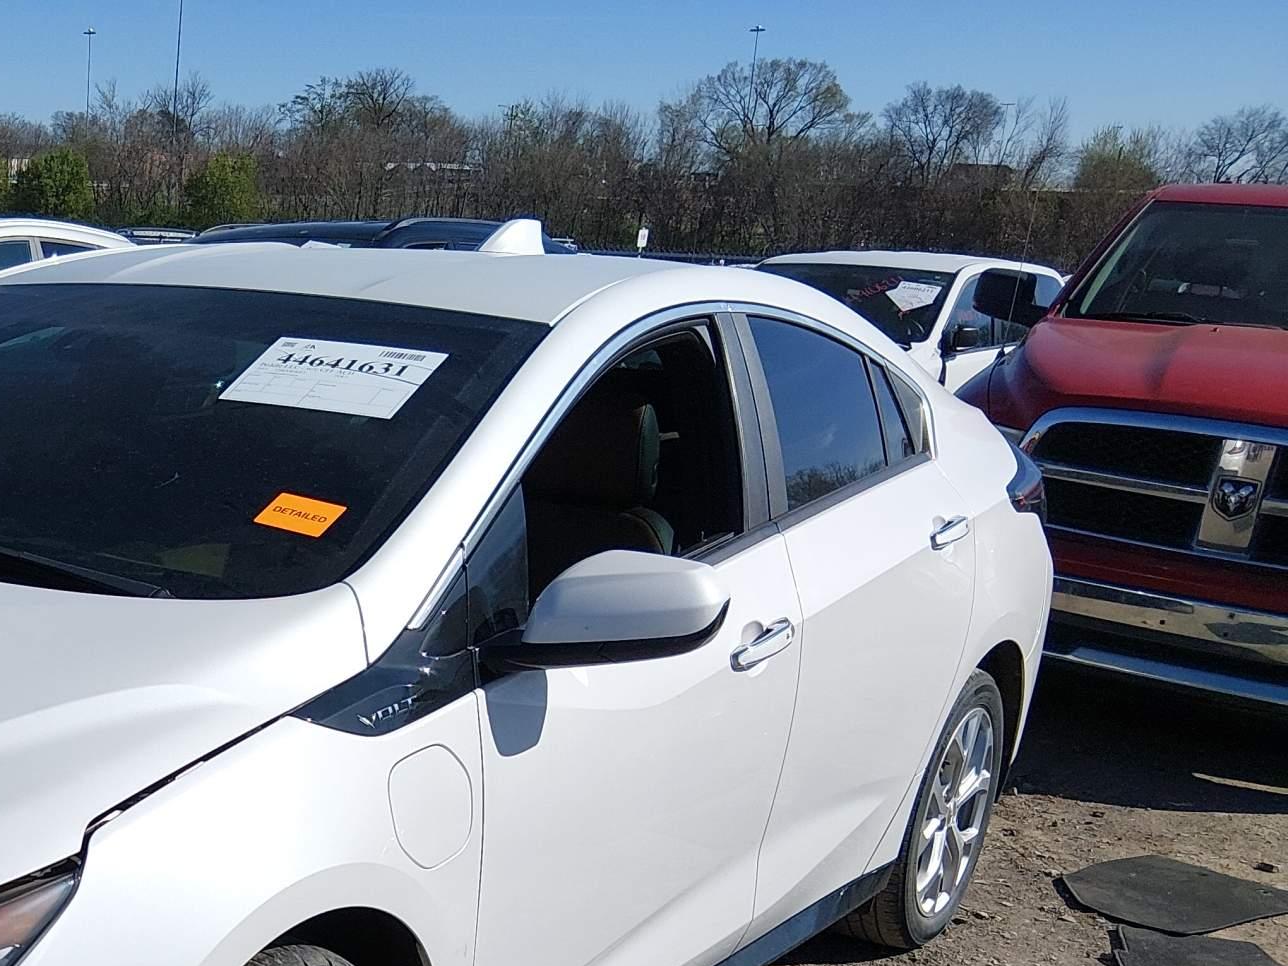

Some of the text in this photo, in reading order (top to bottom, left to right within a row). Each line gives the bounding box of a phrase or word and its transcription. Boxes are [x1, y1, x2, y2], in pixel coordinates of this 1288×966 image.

[276, 352, 409, 377] 44641631
[272, 504, 328, 523] DETAILED
[356, 694, 418, 729] VOLT
